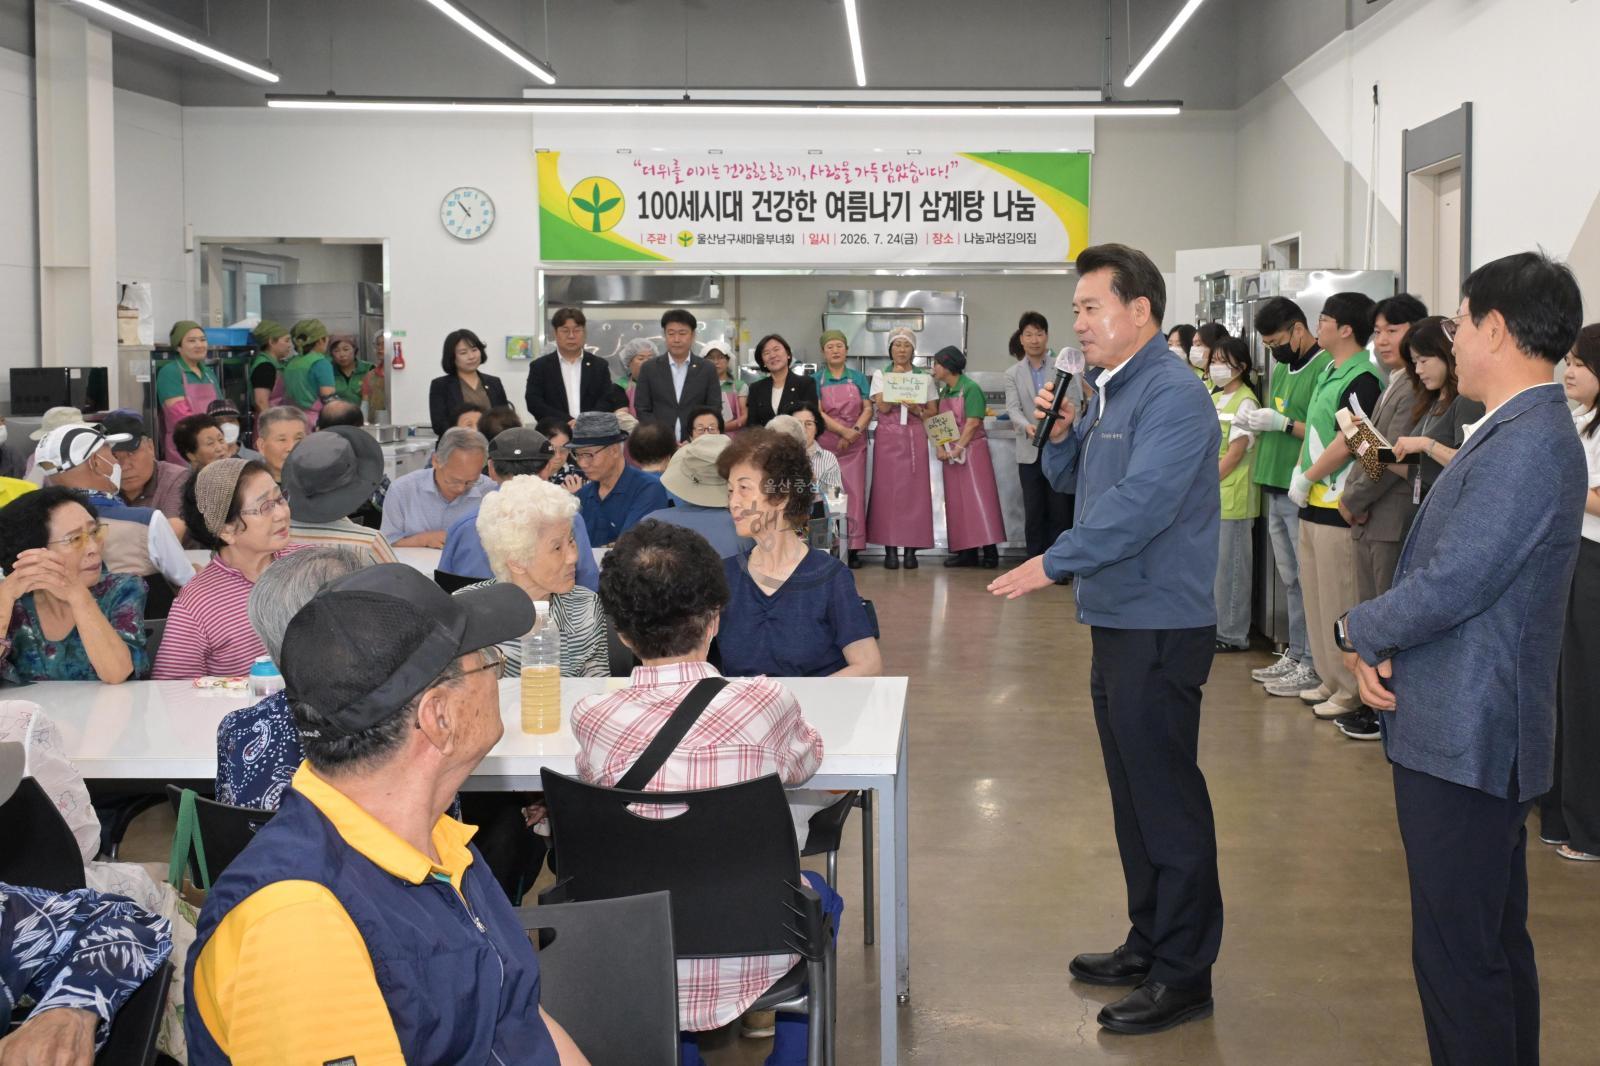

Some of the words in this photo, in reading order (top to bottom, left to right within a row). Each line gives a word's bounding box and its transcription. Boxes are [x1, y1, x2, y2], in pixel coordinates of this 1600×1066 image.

[686, 165, 720, 180] 이기는
[723, 164, 767, 181] 건강한
[810, 160, 853, 185] 사랑을
[855, 161, 878, 183] 가득
[638, 190, 742, 222] 100세시대
[752, 190, 817, 223] 건강한
[825, 190, 911, 223] 여름나기
[920, 190, 984, 223] 삼계탕
[993, 189, 1036, 222] 나눔
[646, 233, 666, 245] 주관
[697, 233, 795, 245] 울산남구새마을부녀회
[808, 233, 830, 245] 일시
[840, 233, 870, 245] 2026.
[874, 234, 883, 245] 7.
[886, 233, 918, 246] 24(금)
[932, 233, 954, 245] 장소
[964, 233, 1037, 245] 나눔과섬김의집
